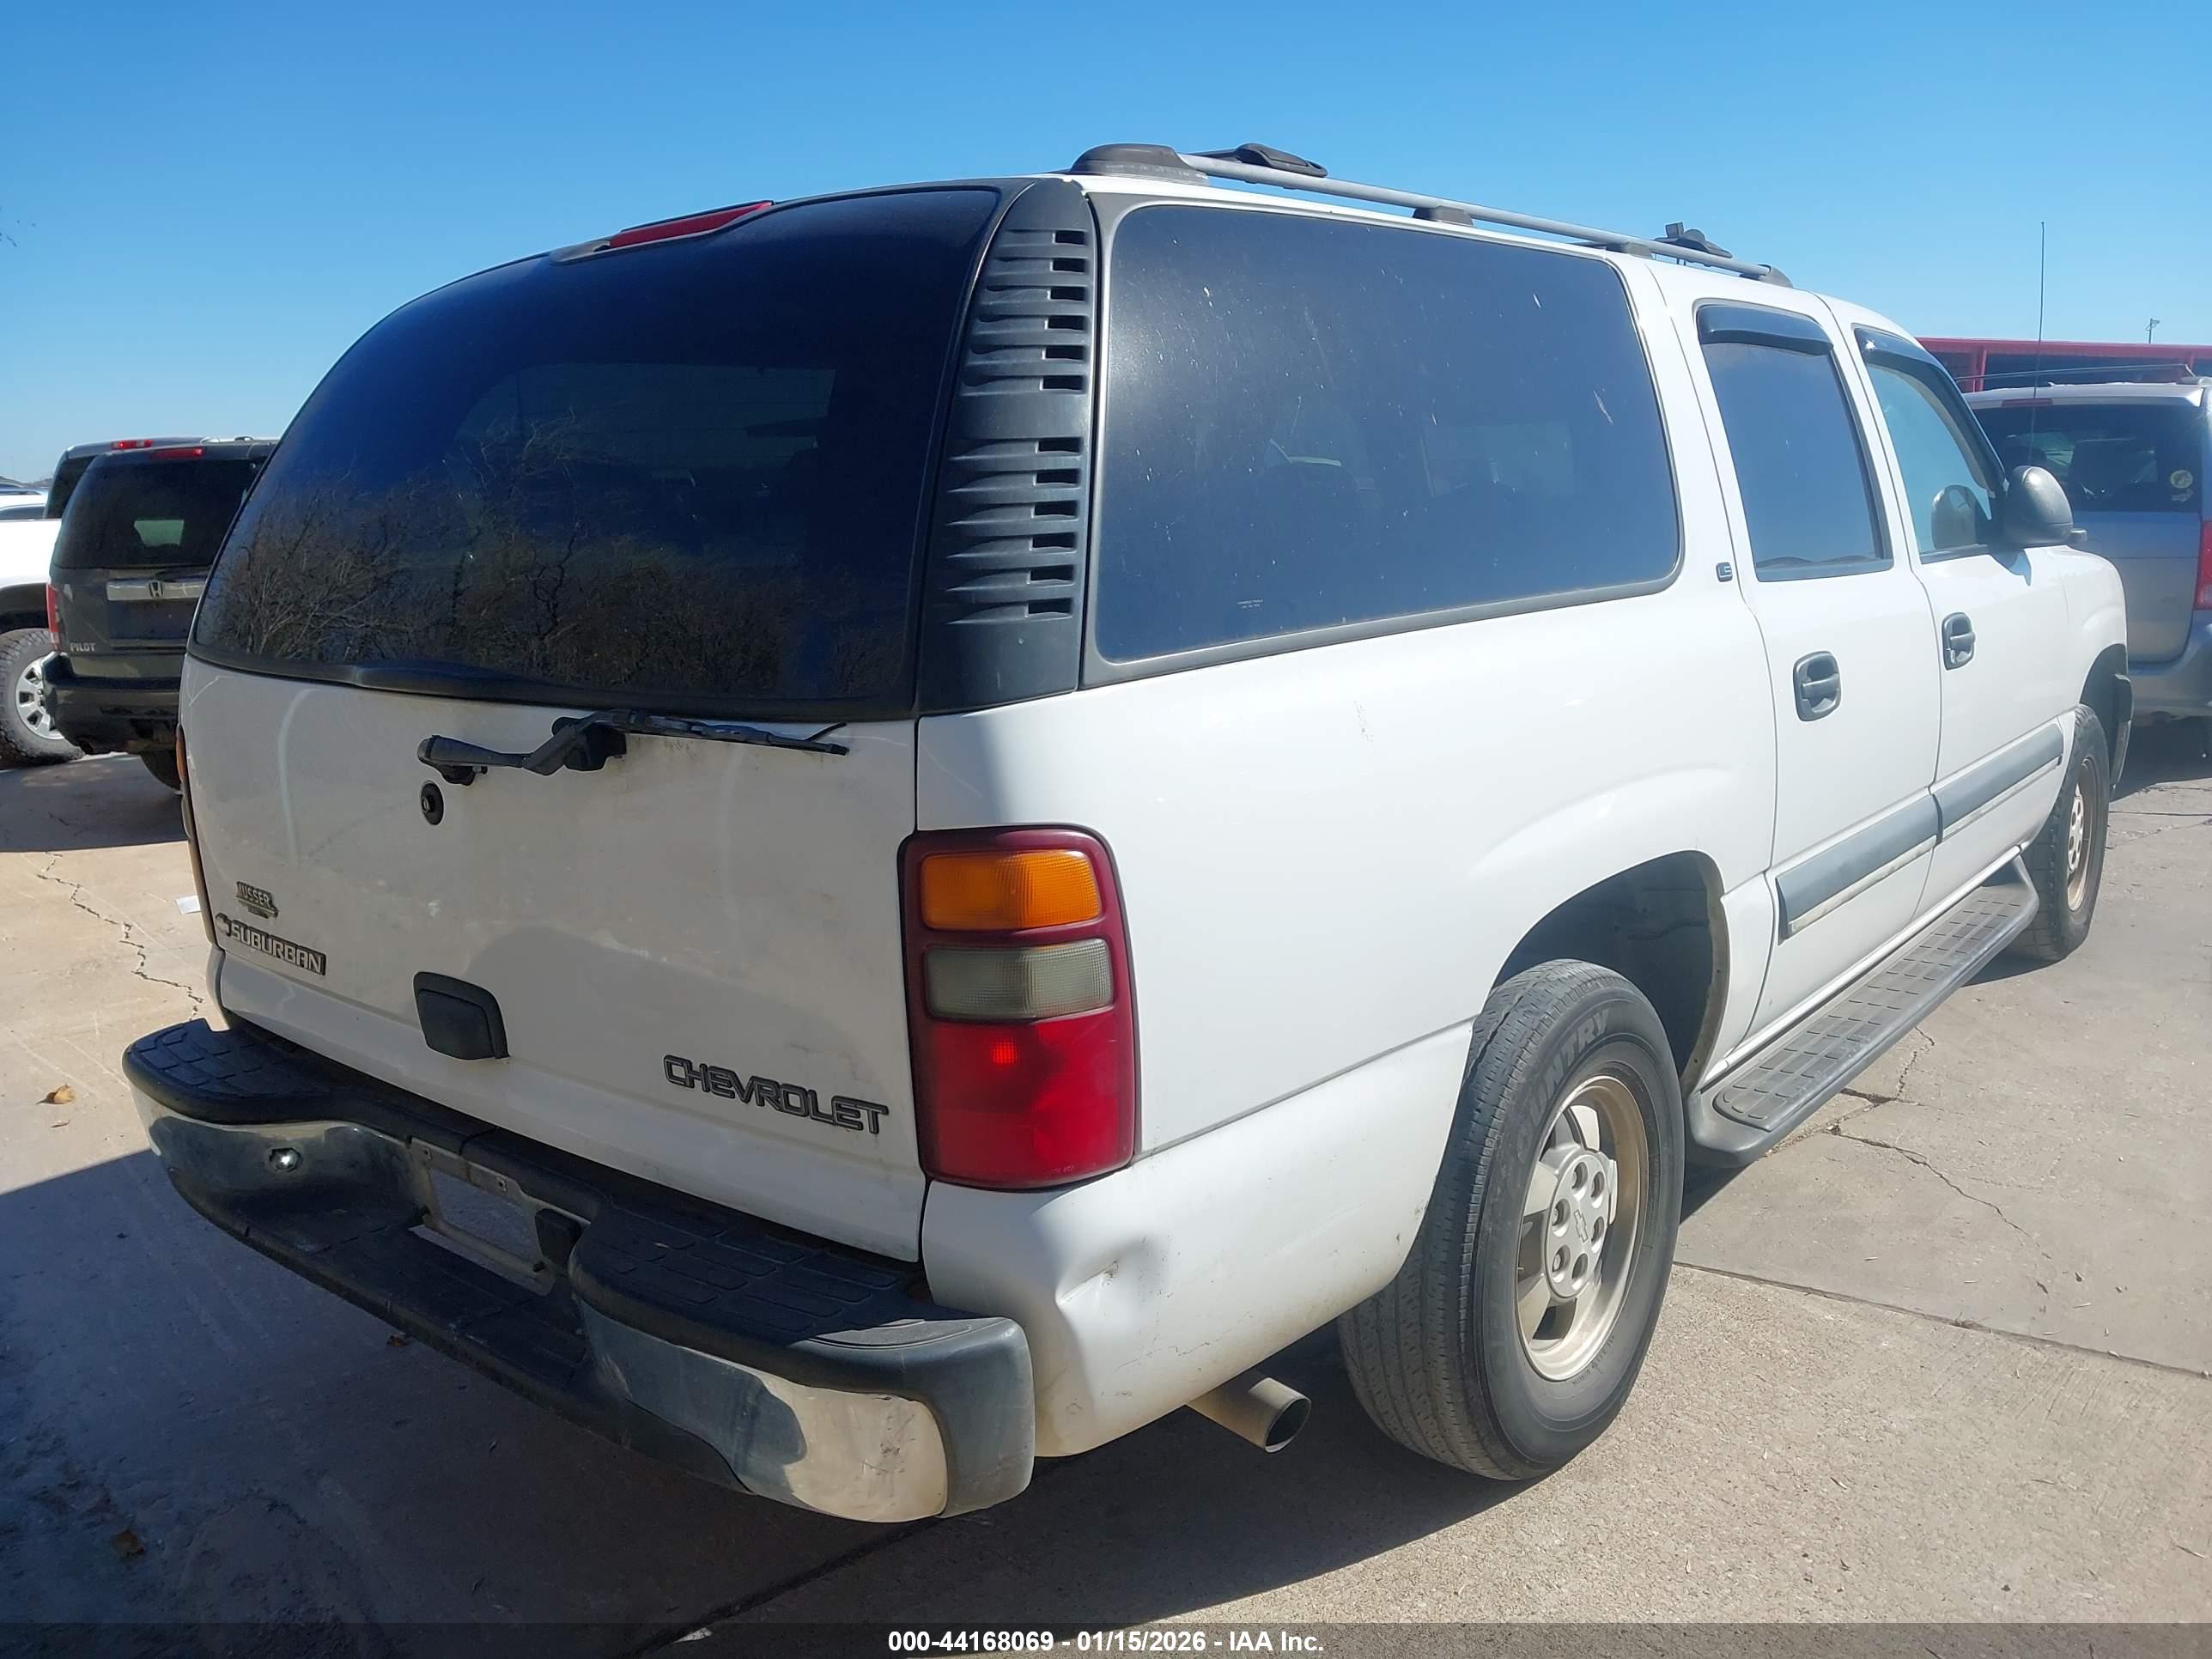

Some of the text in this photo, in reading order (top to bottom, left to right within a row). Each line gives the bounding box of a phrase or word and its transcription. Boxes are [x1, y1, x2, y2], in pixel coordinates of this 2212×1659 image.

[70, 642, 95, 652] PILOT
[230, 919, 326, 975] SUBURBAN
[663, 1054, 890, 1135] CHEVROLET
